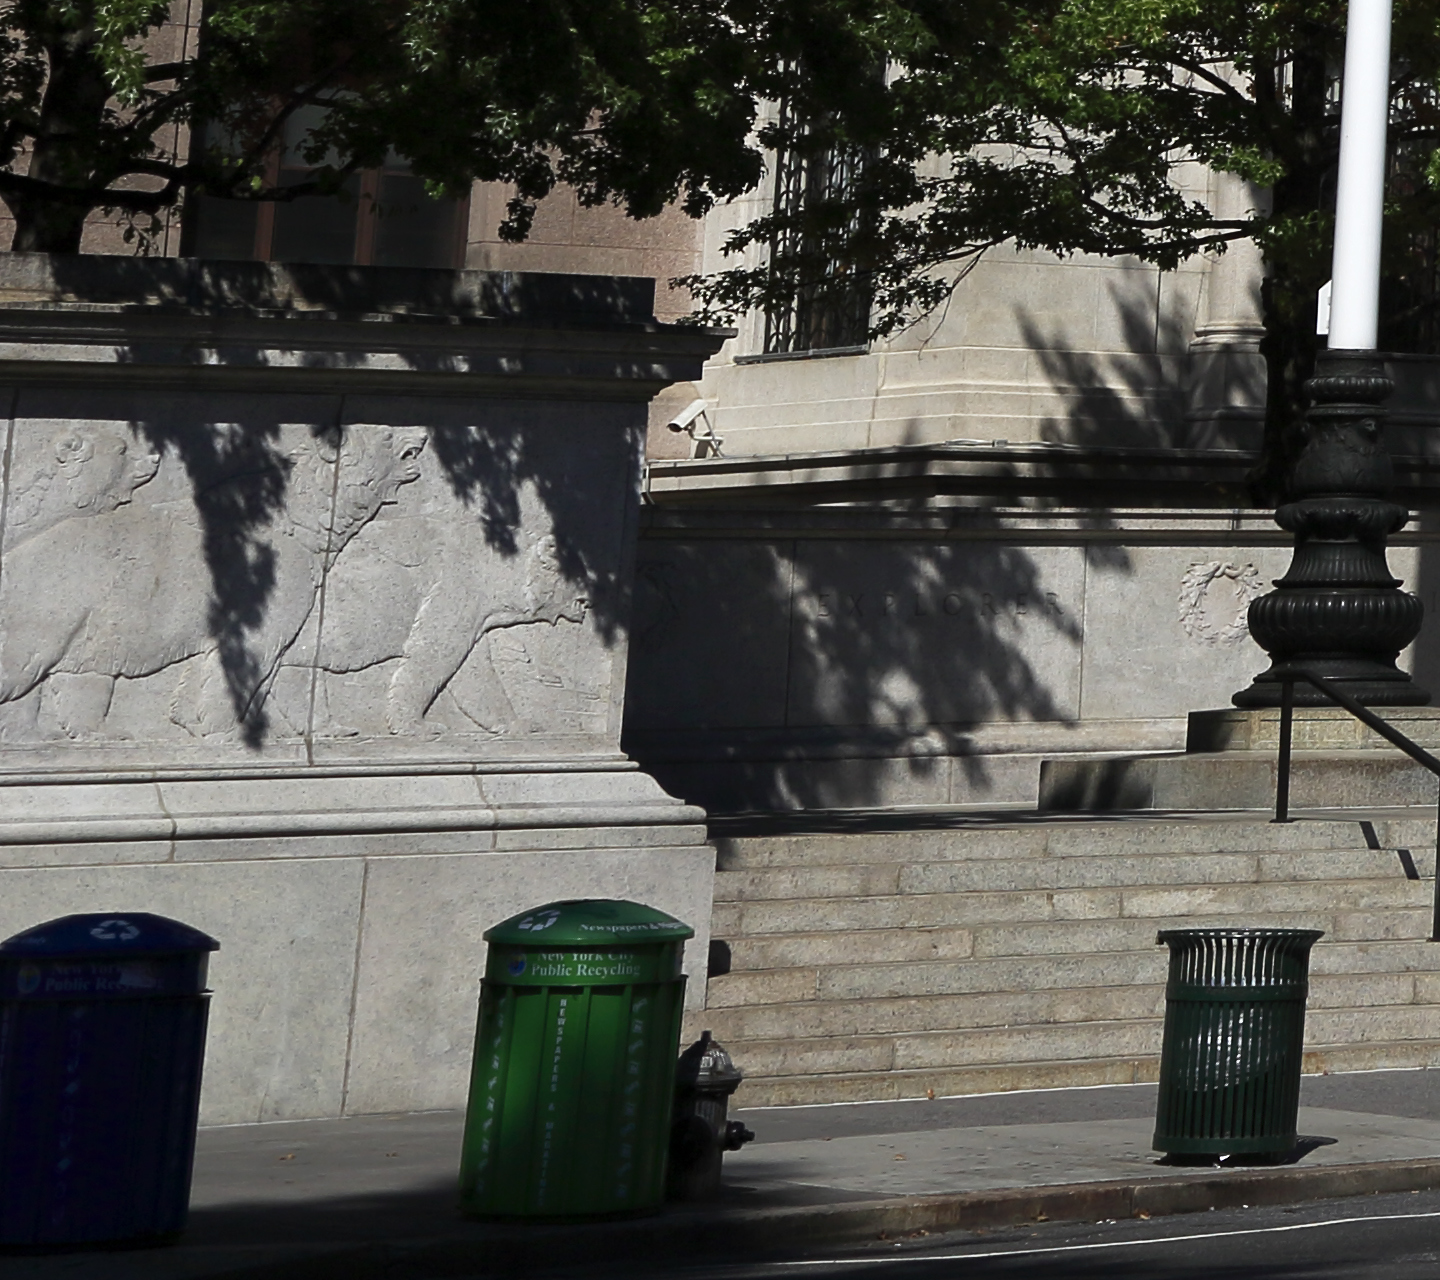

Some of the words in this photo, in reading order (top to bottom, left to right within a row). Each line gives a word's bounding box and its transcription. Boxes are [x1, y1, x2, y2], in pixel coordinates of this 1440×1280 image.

[816, 592, 1066, 617] EXPLORER
[531, 962, 573, 977] Public
[576, 962, 640, 979] Recycling
